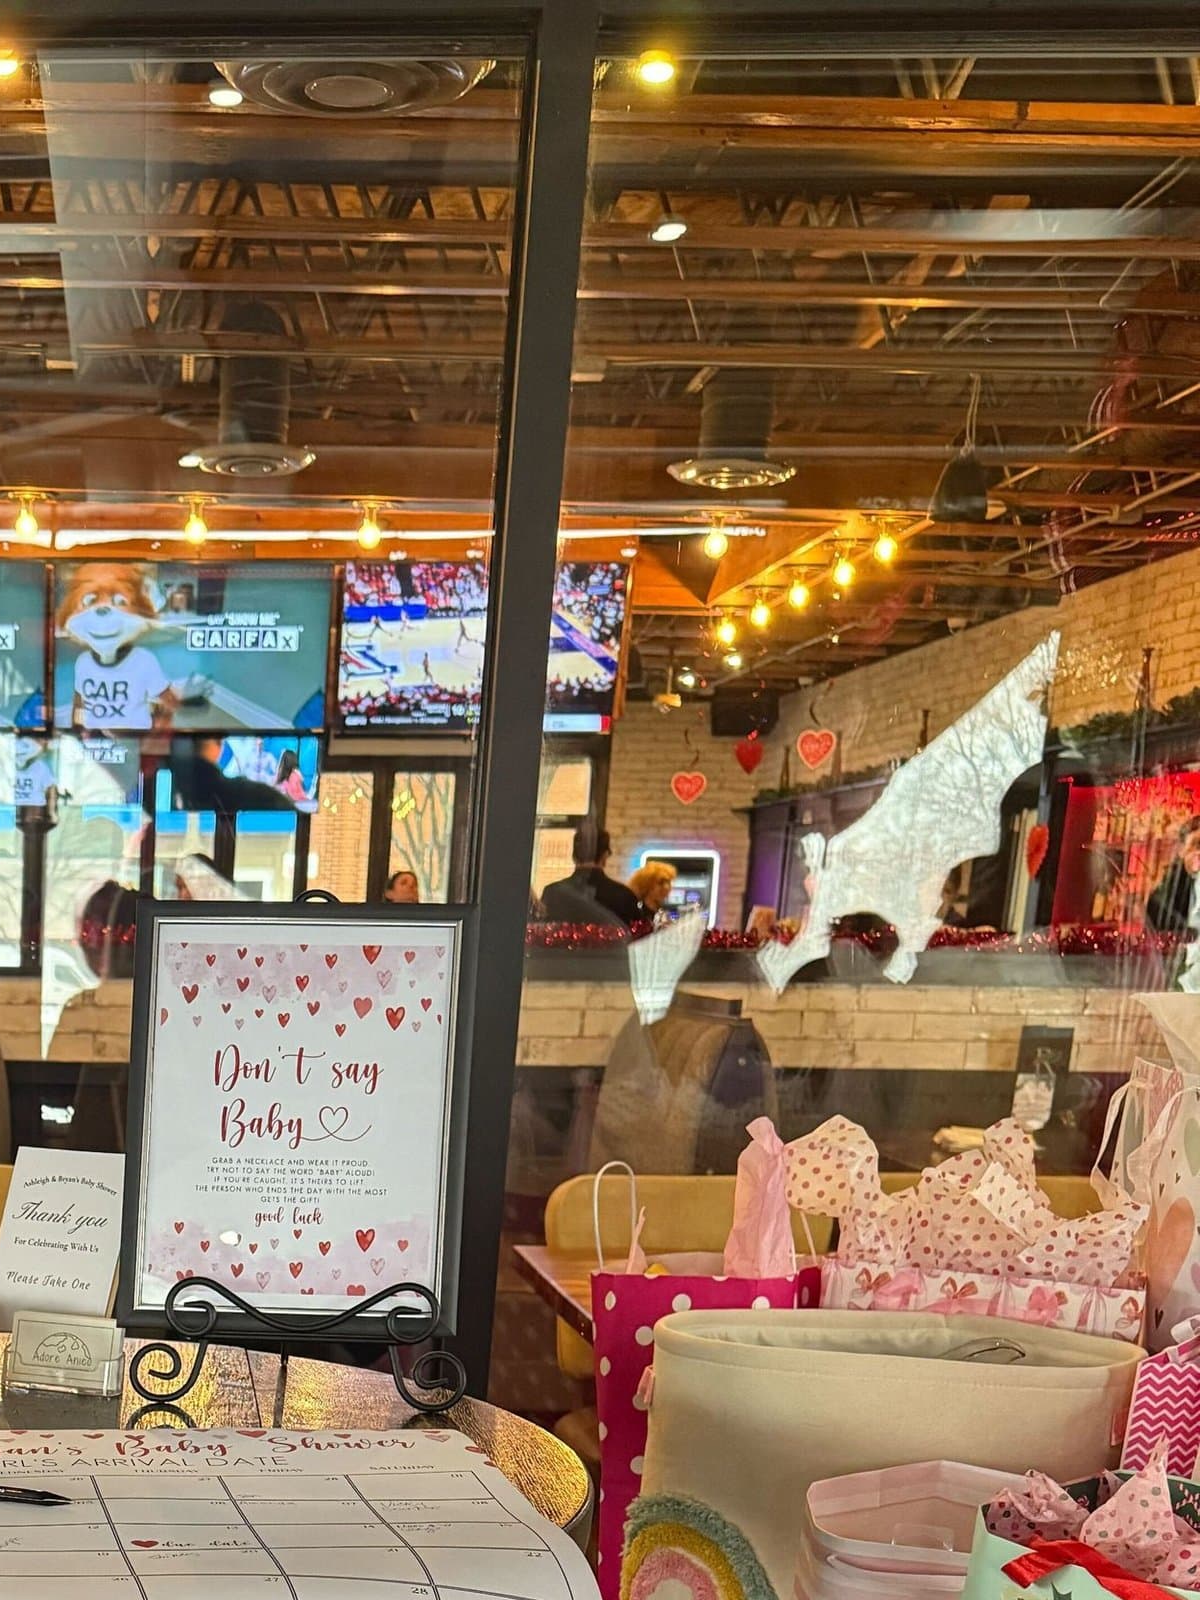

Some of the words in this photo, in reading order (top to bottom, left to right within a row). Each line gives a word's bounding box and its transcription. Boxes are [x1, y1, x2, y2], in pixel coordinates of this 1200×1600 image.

[190, 630, 294, 649] CARFAX
[83, 679, 129, 701] CAR
[214, 1044, 326, 1092] Don't
[331, 1061, 384, 1095] say
[220, 1098, 302, 1150] Baby
[23, 1176, 50, 1188] Ashleigh
[58, 1175, 80, 1185] Bryan's
[80, 1177, 95, 1188] Baby
[95, 1182, 117, 1196] Shower
[267, 1186, 287, 1194] ENDS
[364, 1188, 387, 1196] MOST
[12, 1200, 76, 1224] Thank
[67, 1216, 108, 1235] you
[255, 1206, 284, 1227] good
[292, 1207, 324, 1225] luck
[14, 1236, 27, 1245] For
[28, 1238, 69, 1252] Celebrating
[70, 1242, 88, 1252] With
[90, 1244, 99, 1253] Us
[6, 1271, 39, 1285] Please
[42, 1275, 67, 1288] Take
[72, 1278, 91, 1290] One
[33, 1352, 60, 1363] Adore
[116, 1437, 232, 1457] Baby
[259, 1436, 417, 1453] Shower
[71, 1458, 195, 1467] ARRIVAL
[206, 1456, 289, 1467] DATE
[411, 1587, 429, 1596] 28
